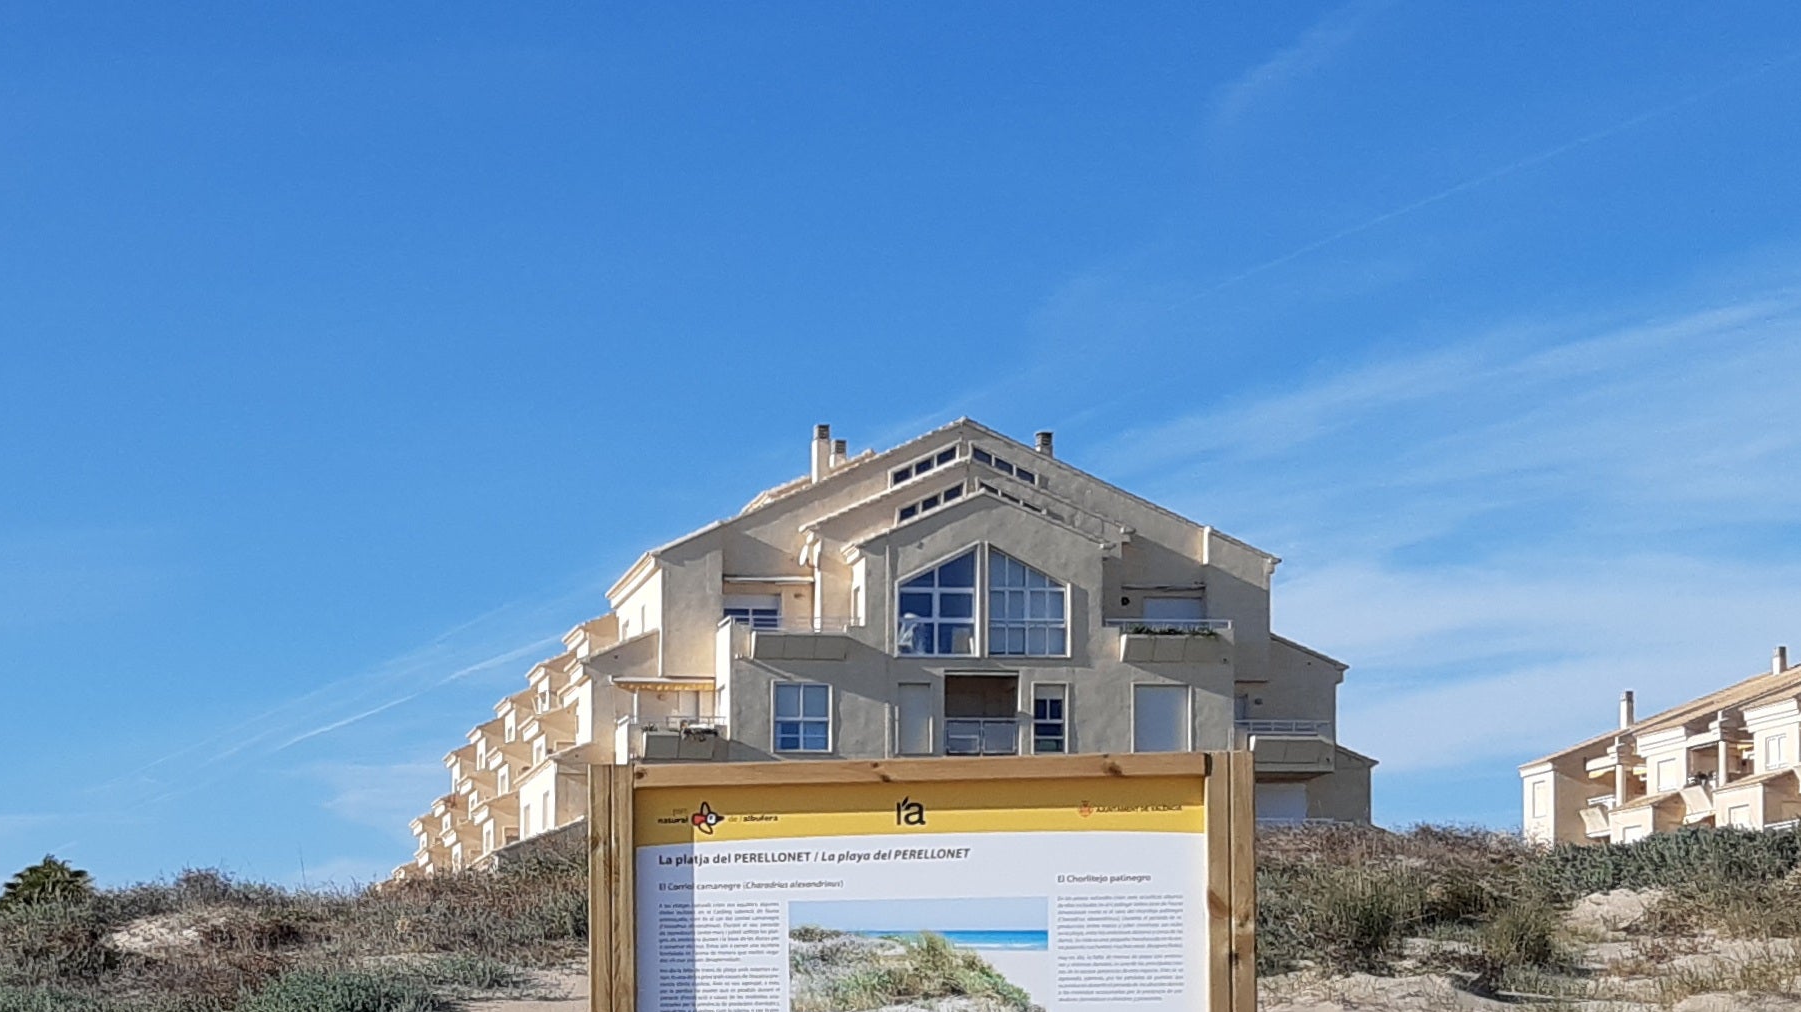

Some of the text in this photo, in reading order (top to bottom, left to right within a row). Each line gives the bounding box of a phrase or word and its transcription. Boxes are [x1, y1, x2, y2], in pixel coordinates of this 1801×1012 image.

[658, 816, 689, 824] natural
[659, 855, 673, 865] La
[676, 854, 710, 866] platja
[713, 853, 731, 864] del
[734, 851, 811, 863] PERELLONET
[821, 852, 835, 862] La
[837, 850, 870, 864] playa
[873, 849, 892, 861] del
[893, 848, 971, 860] PERELLONET
[1067, 874, 1108, 883] Chorlitejo
[1110, 873, 1151, 883] patinegro
